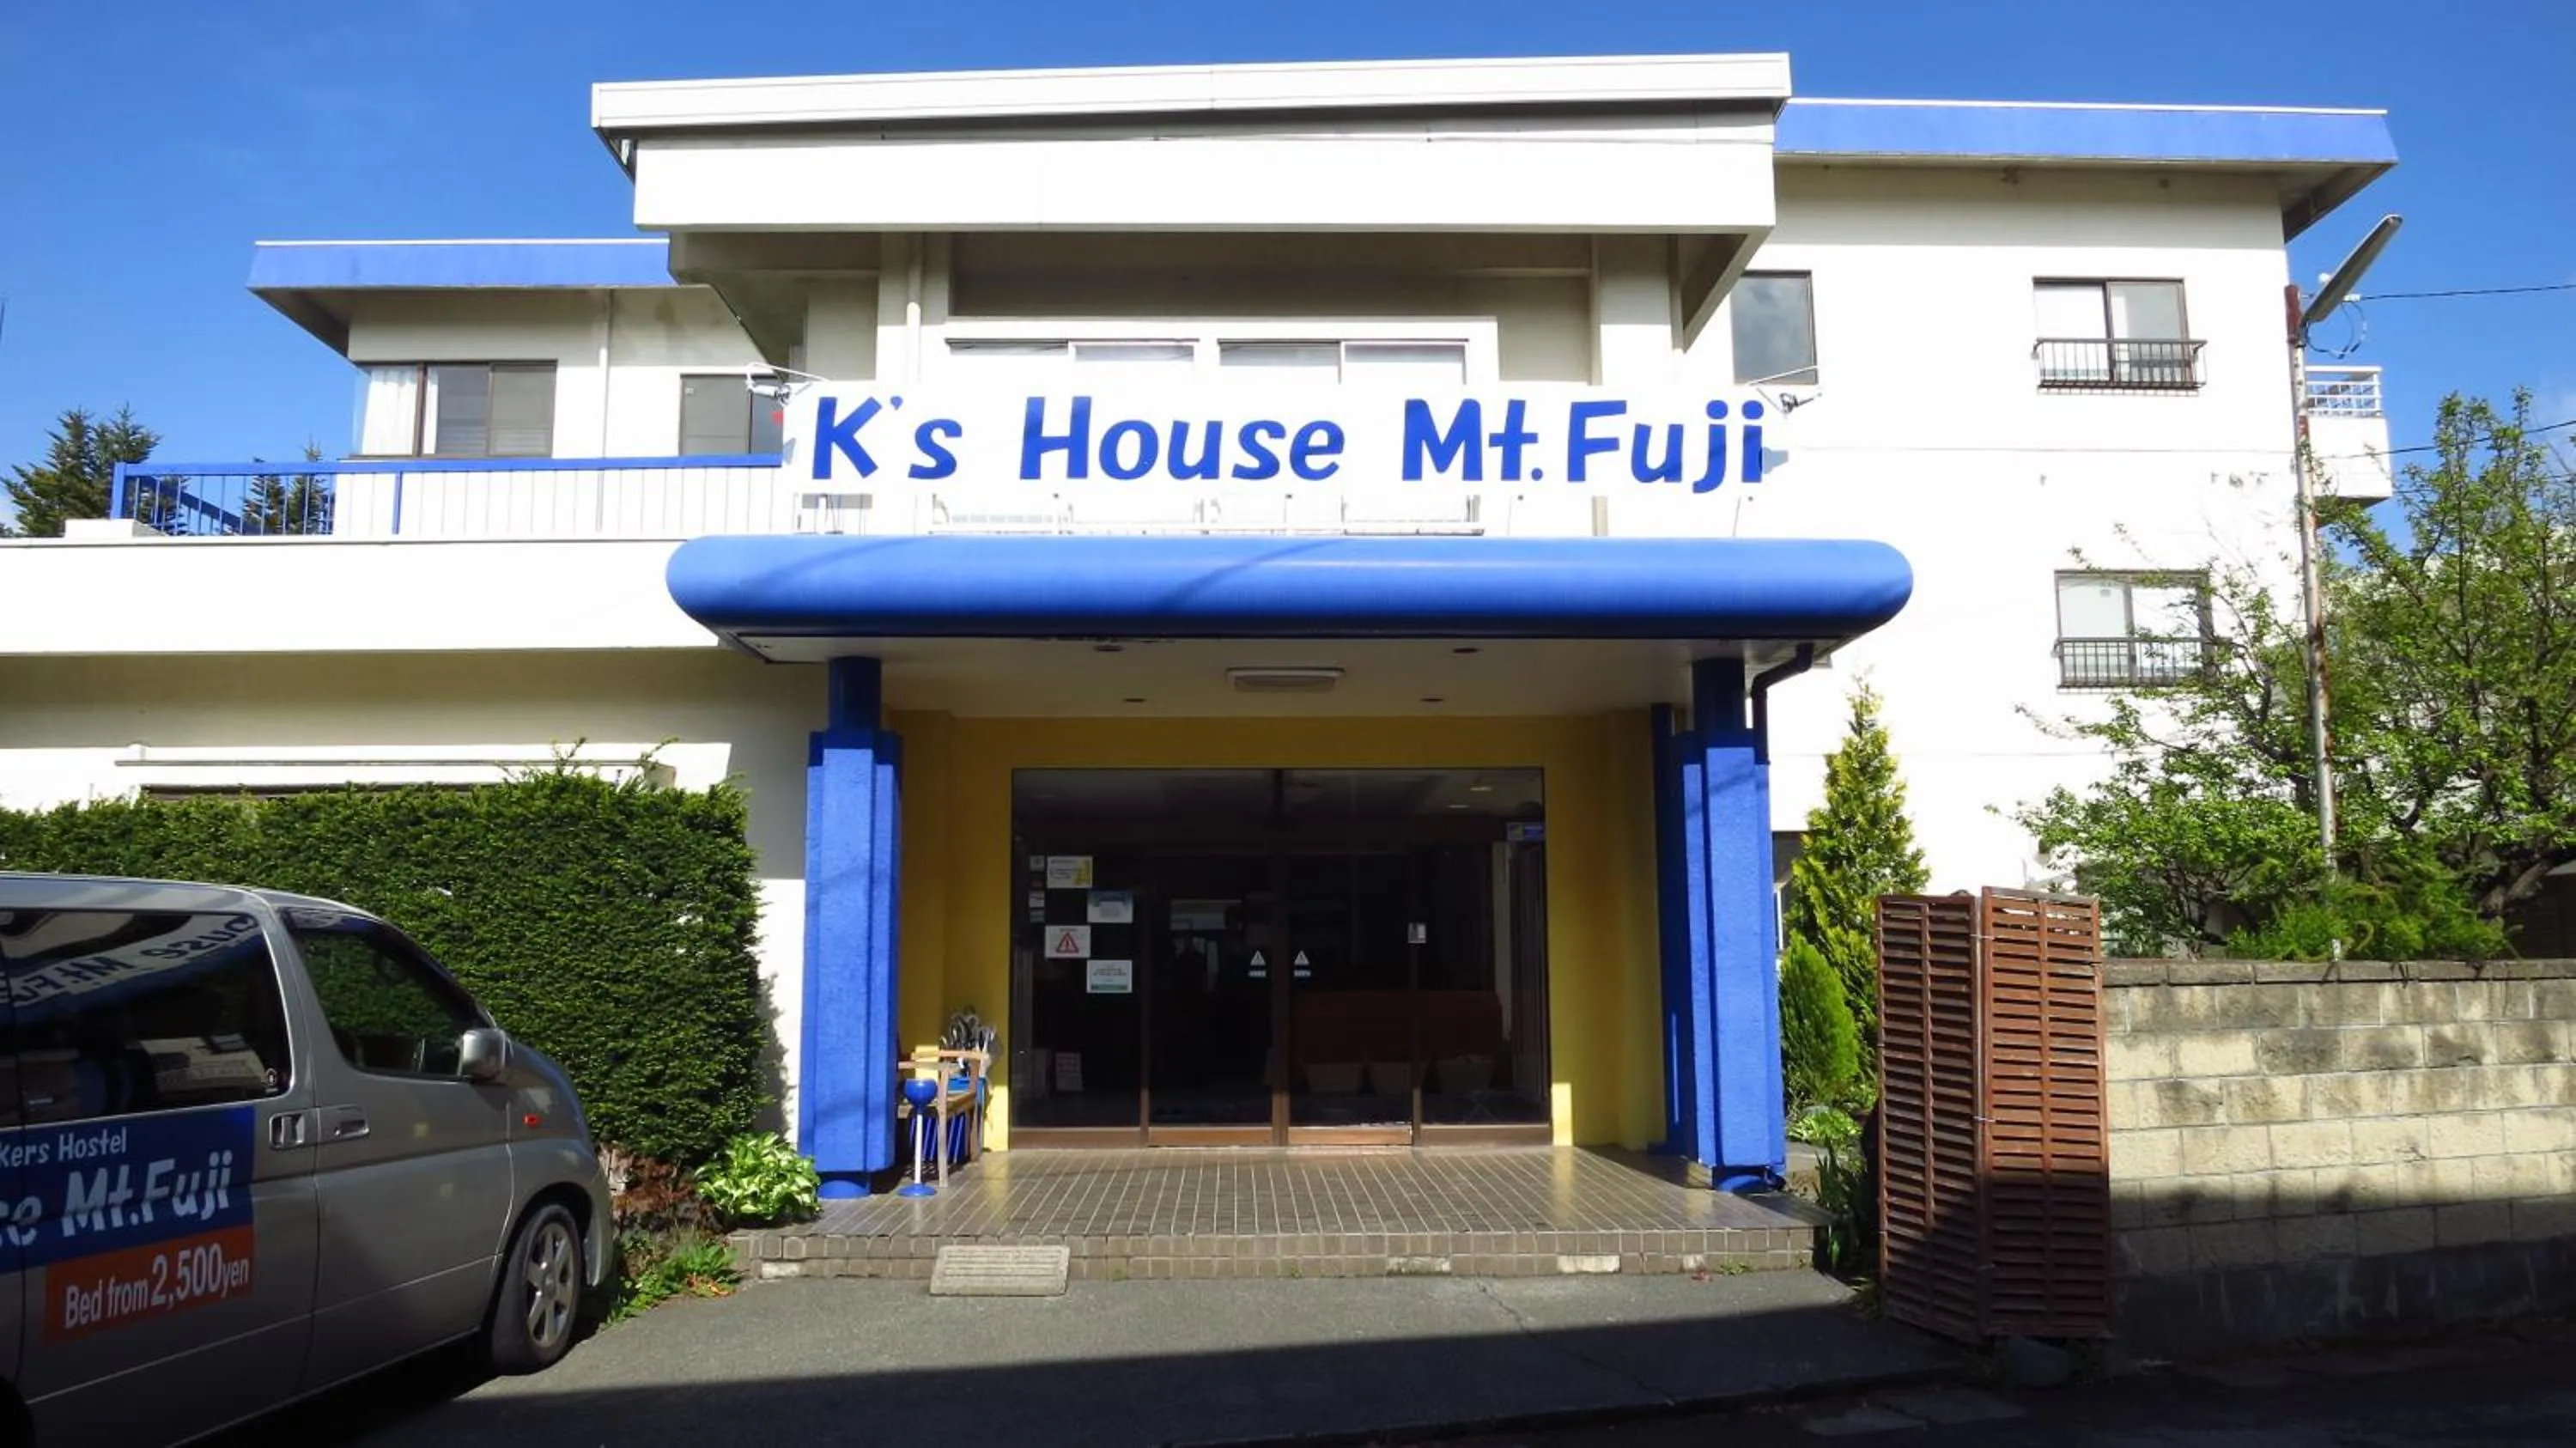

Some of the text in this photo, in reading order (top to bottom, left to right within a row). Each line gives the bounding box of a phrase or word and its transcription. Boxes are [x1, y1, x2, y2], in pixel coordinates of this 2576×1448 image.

[812, 396, 963, 480] K's
[1019, 396, 1345, 481] House
[58, 1126, 127, 1162] Hostel
[61, 1149, 234, 1238] Mt.Fuji
[64, 1279, 103, 1329] Bed
[106, 1276, 149, 1317] from
